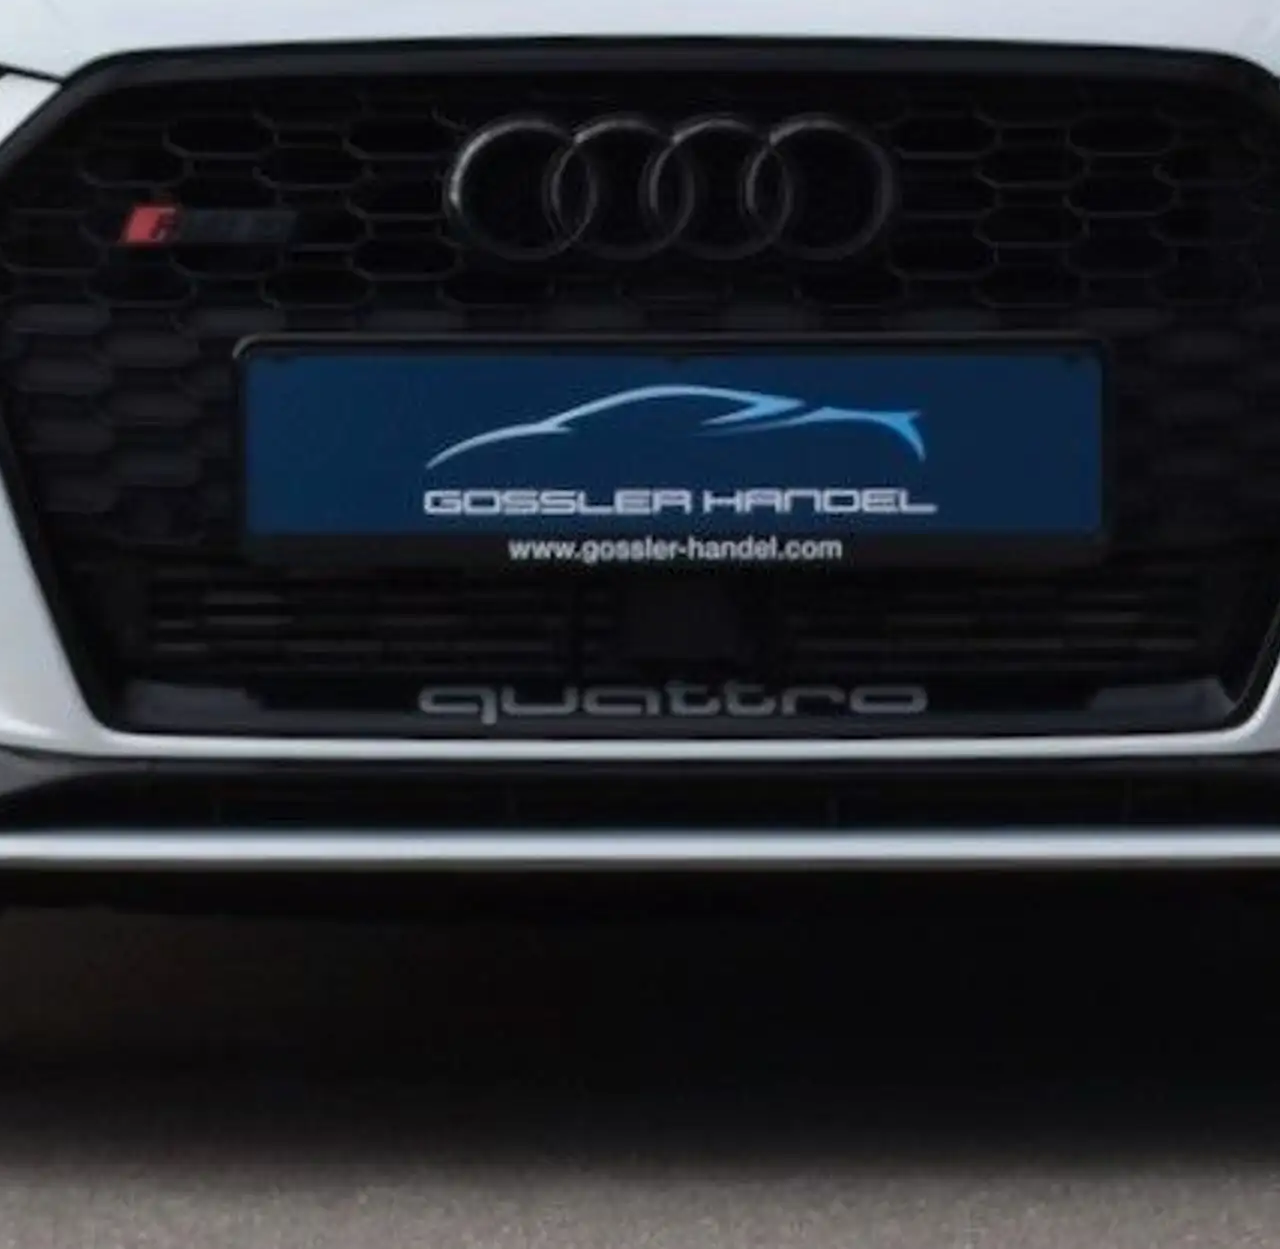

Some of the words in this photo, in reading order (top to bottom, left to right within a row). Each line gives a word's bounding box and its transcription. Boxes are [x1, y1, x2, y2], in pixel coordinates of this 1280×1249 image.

[423, 488, 693, 516] GOSSLER
[702, 487, 937, 515] HANDEL
[508, 535, 842, 564] www.gossler-handel.com
[419, 683, 927, 726] quattro
